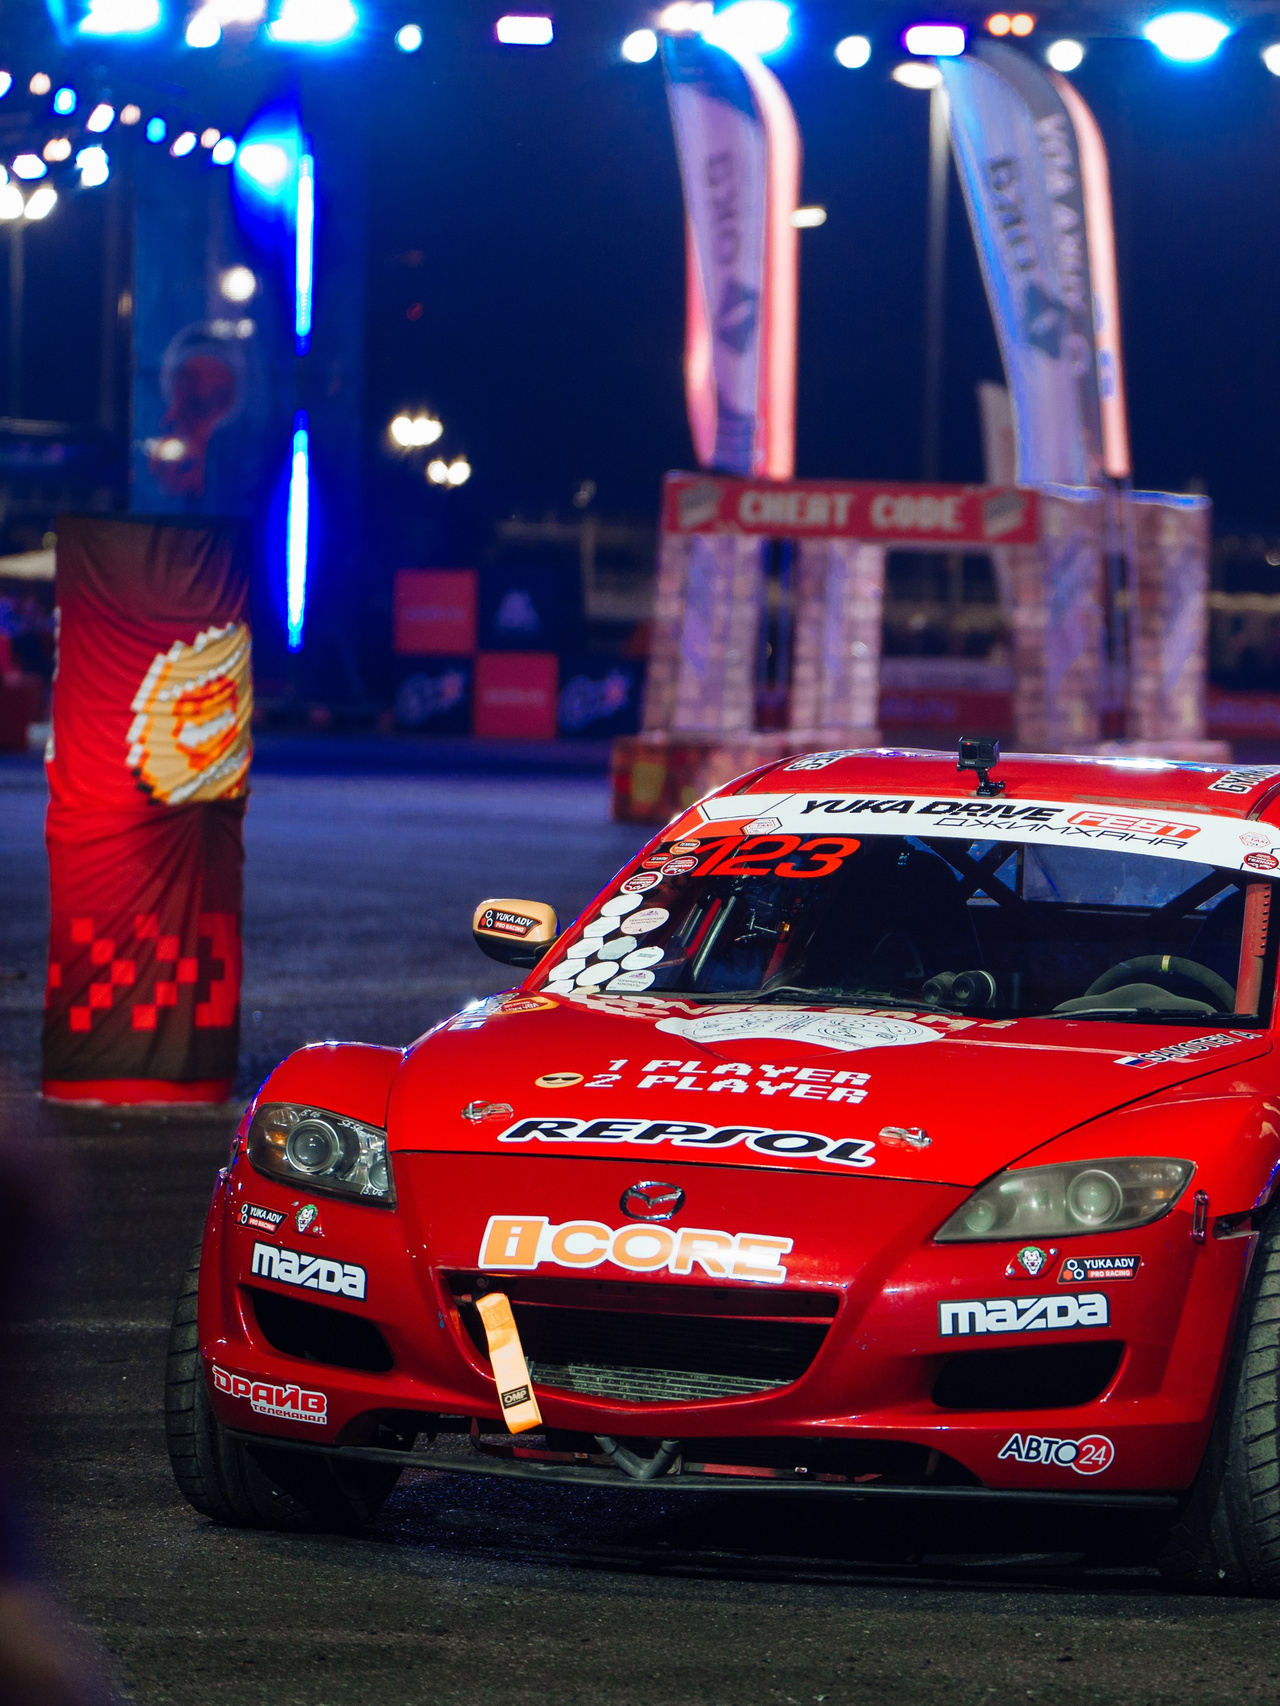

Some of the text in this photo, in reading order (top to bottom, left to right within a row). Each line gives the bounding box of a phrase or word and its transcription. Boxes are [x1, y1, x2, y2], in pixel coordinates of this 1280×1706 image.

[800, 799, 916, 814] YUKA
[915, 801, 1064, 821] DRIVE
[933, 817, 1188, 849] ДЖИМХАНА
[690, 835, 861, 878] 123
[496, 912, 534, 926] YUKA ADV
[608, 1059, 871, 1086] 1 PLAYER
[584, 1074, 868, 1104] 2 PLAYER
[499, 1118, 875, 1166] REPSOL
[250, 1207, 282, 1223] YUKA ADV
[251, 1243, 366, 1299] mazda
[1084, 1258, 1135, 1269] YUKA ADV
[1105, 1269, 1131, 1277] RACING
[941, 1293, 1108, 1335] mazda
[504, 1390, 528, 1405] OMP
